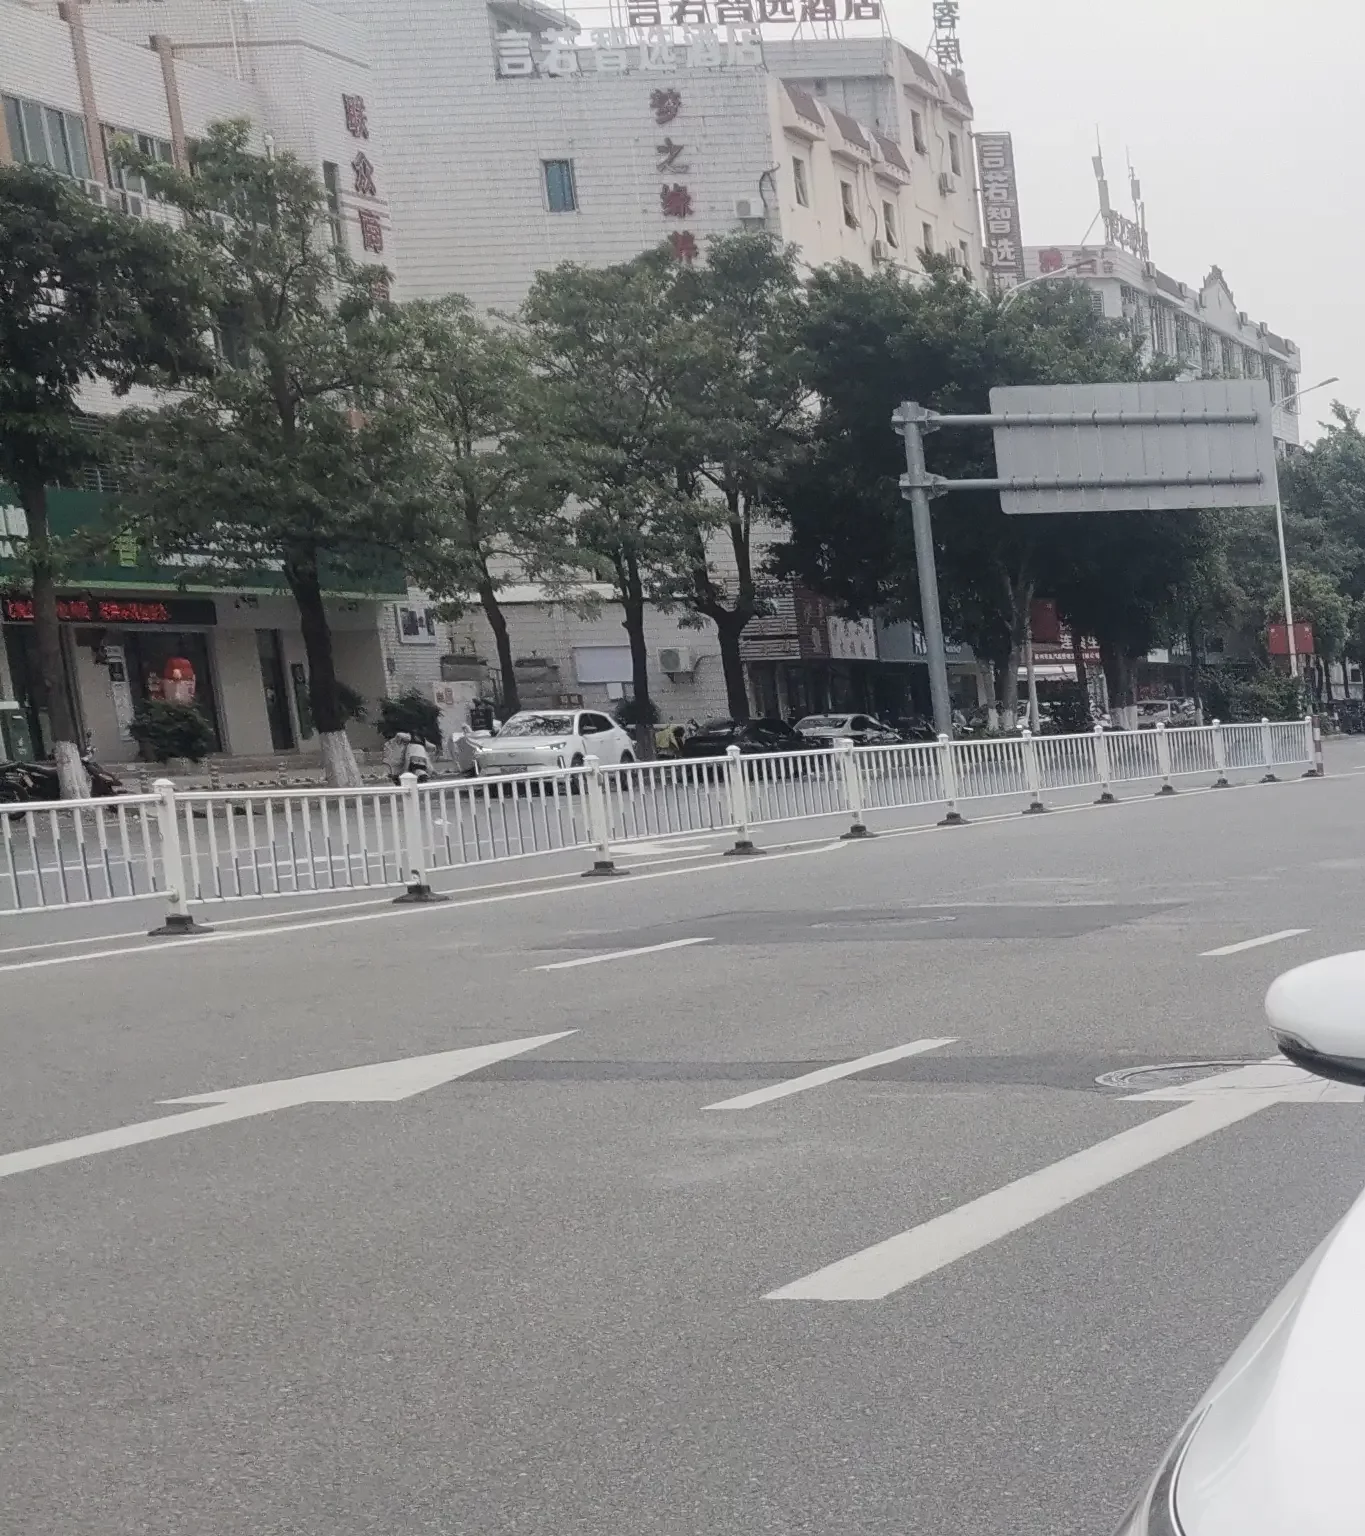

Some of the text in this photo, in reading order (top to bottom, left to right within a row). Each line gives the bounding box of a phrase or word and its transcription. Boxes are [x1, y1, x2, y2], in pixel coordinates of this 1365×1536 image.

[498, 26, 763, 77] 言若智选酒店
